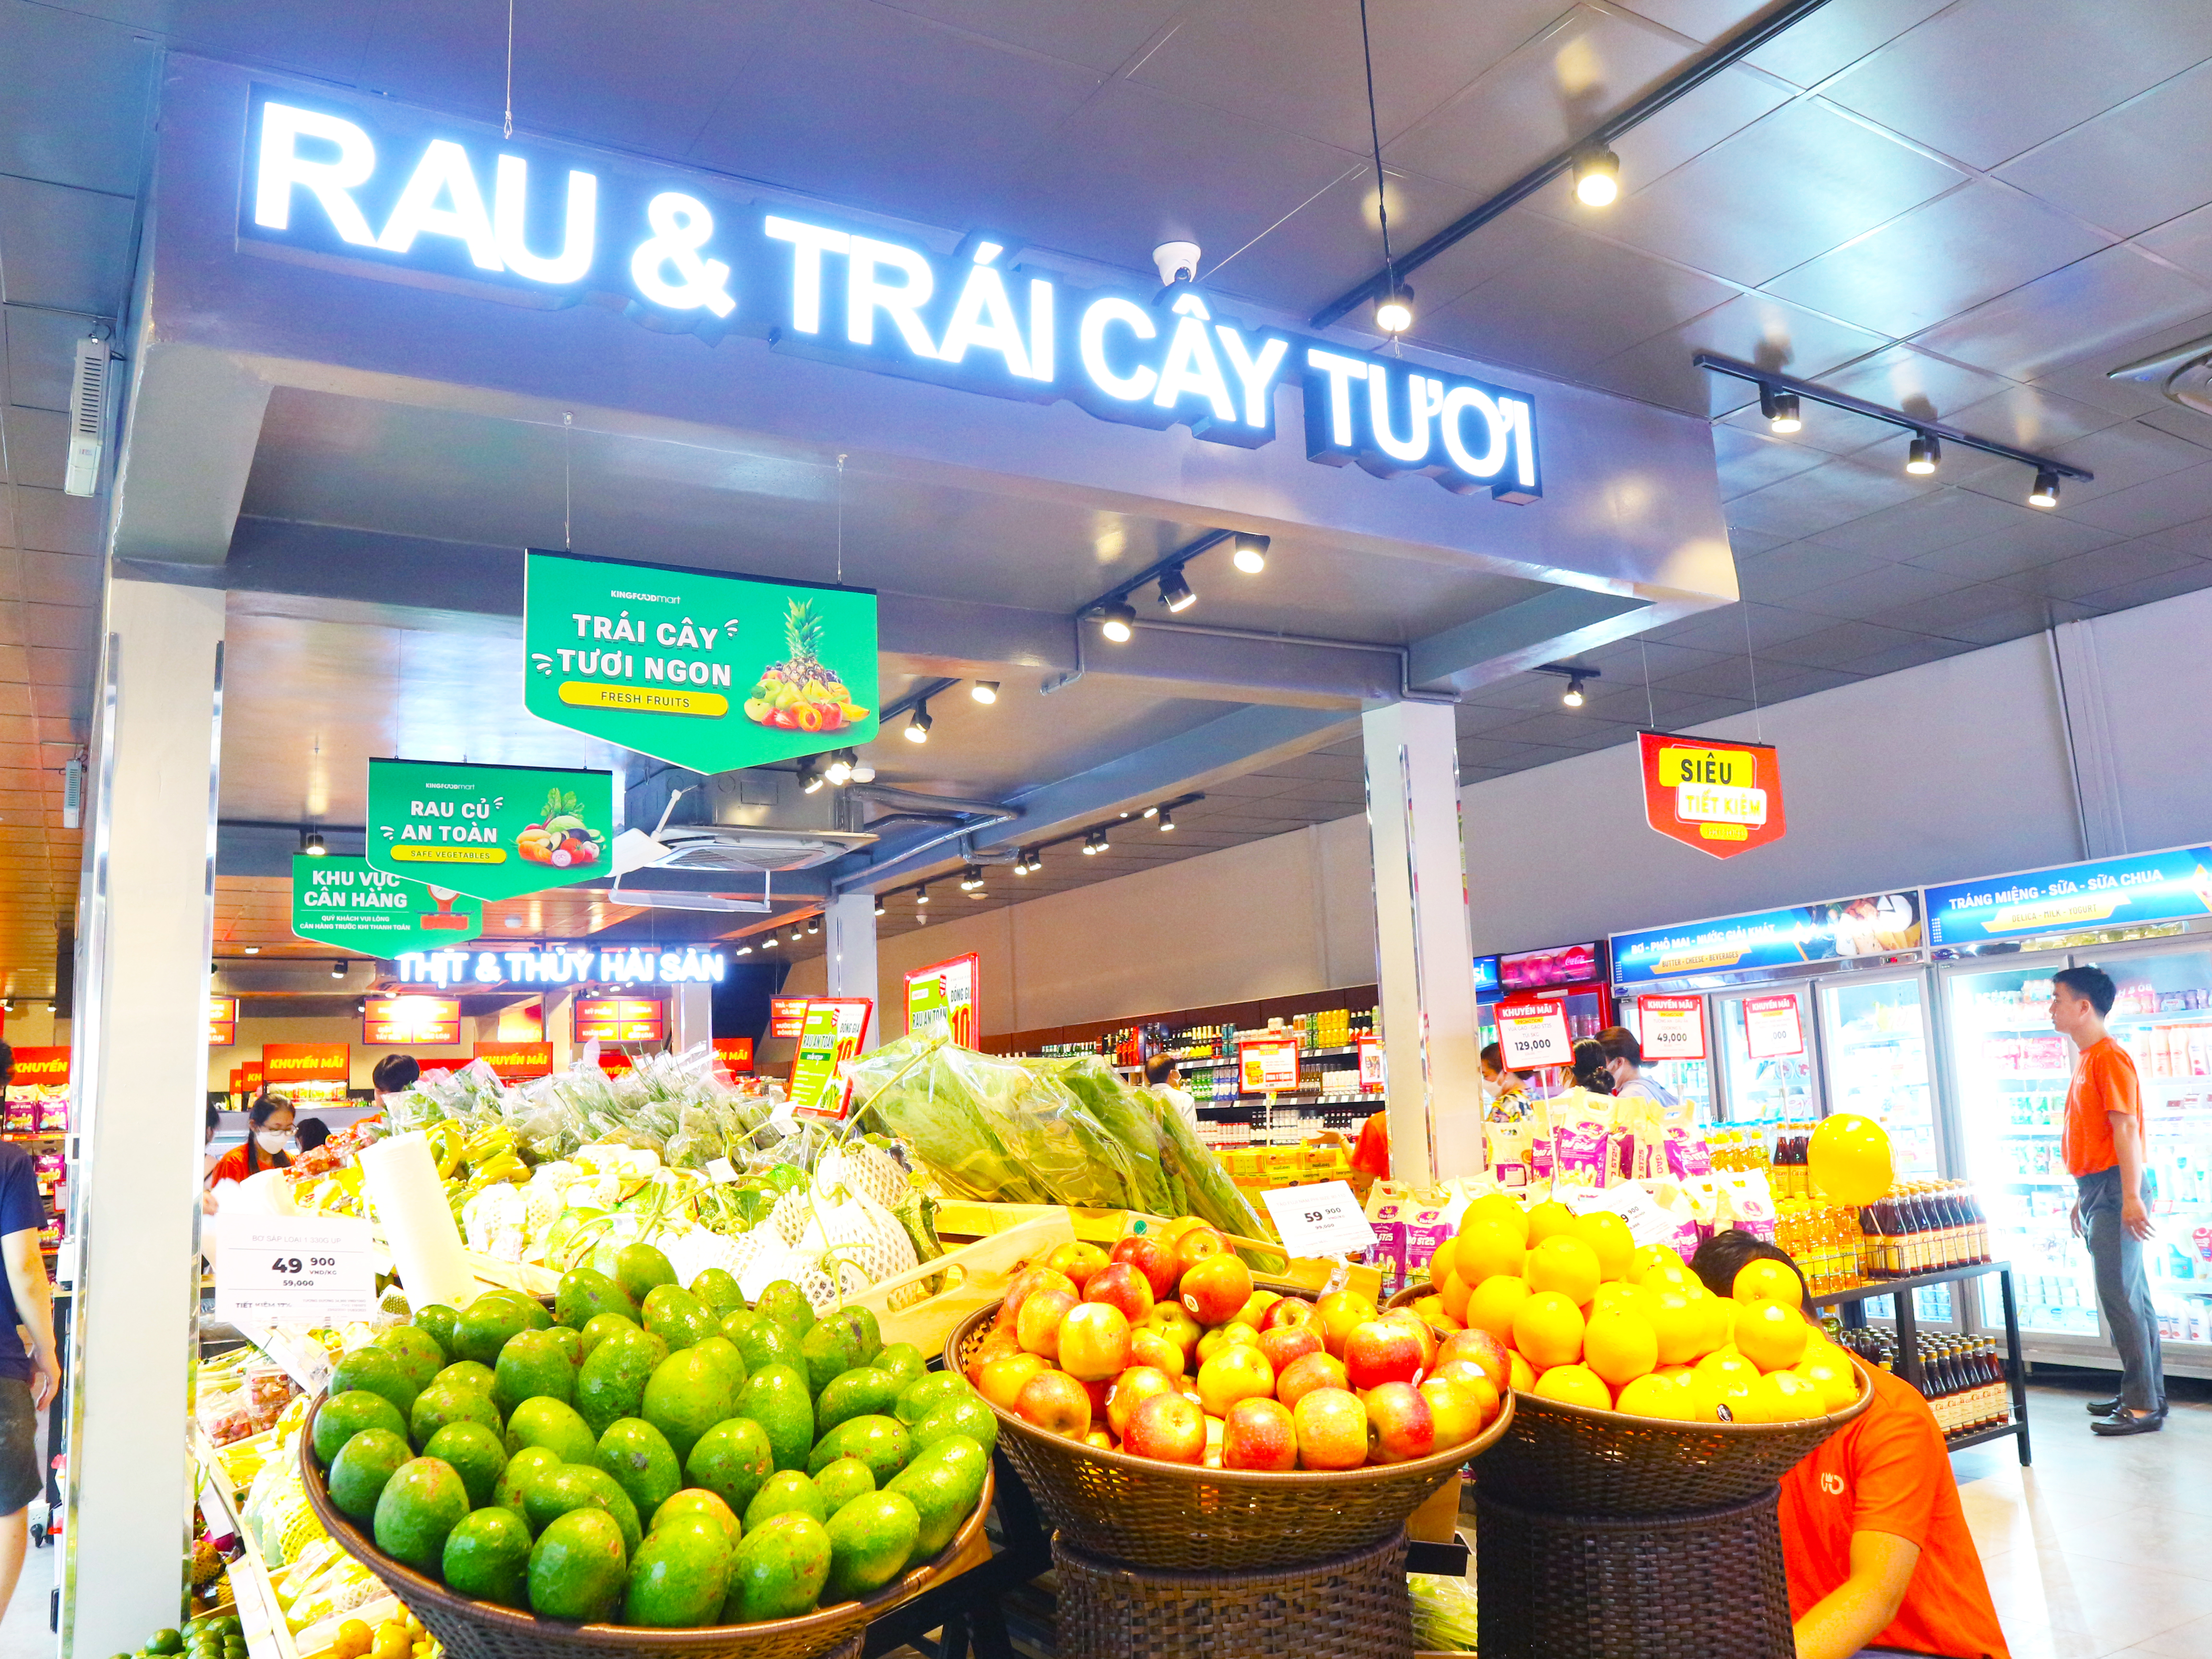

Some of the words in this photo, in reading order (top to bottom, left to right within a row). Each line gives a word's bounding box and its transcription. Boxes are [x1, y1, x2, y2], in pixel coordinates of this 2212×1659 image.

[255, 101, 596, 283] RAU
[631, 192, 735, 318] &
[766, 215, 1053, 382] TRÁI
[1080, 293, 1288, 428] CÂY
[1308, 349, 1535, 486] TƯƠI
[572, 610, 645, 644] TRÁI
[656, 617, 718, 649] CÂY
[557, 648, 633, 678] TƯƠI
[644, 657, 731, 687] NGON
[601, 691, 642, 704] FRESH
[647, 695, 690, 708] FRUITS
[1681, 752, 1731, 784] SIÊU
[410, 801, 454, 817] RAU
[461, 798, 490, 819] CỦ
[1686, 788, 1719, 813] TIẾT
[1724, 793, 1761, 820] KIỆM
[401, 825, 432, 841] AN
[439, 822, 497, 843] TOÀN
[313, 870, 354, 886] KHU
[304, 887, 346, 906] CÂN
[352, 888, 407, 908] HÀNG
[1949, 892, 1993, 910] TRÁNG
[1996, 886, 2038, 904] MIỆNG
[2048, 879, 2077, 896] SỮA
[2088, 875, 2118, 891] SỮA
[2120, 869, 2163, 886] CHUA
[2012, 914, 2037, 922] DELICA
[2044, 909, 2060, 918] MILK
[2068, 904, 2097, 915] YOGURT
[1631, 943, 1645, 954] BƠ
[1651, 938, 1671, 951] PHÔ
[1672, 938, 1690, 949] MAI
[1697, 930, 1724, 945] NƯỚC
[1686, 956, 1704, 964] CHEESE
[1709, 951, 1738, 961] BEVERAGES
[395, 952, 469, 988] THỊT
[476, 953, 501, 982] &
[601, 947, 654, 982] HẢI
[660, 948, 724, 982] SẢN
[1503, 1005, 1536, 1017] KHUYẾN
[1537, 1004, 1552, 1014] MÃI
[1647, 999, 1678, 1009] KHUYẾN
[1678, 999, 1693, 1009] MÃI
[1752, 999, 1777, 1010] KHUYẾN
[1778, 998, 1790, 1008] MÃI
[913, 1011, 923, 1028] RAU
[924, 1009, 931, 1025] AN
[803, 1034, 812, 1047] RAU
[813, 1035, 820, 1048] AN
[1515, 1039, 1551, 1051] 129,000
[1658, 1033, 1687, 1043] 49,000
[270, 1055, 318, 1069] KHUYẾN
[321, 1056, 344, 1068] MÃI
[482, 1052, 525, 1065] KHUYẾN
[527, 1053, 548, 1065] MÃI
[729, 1049, 748, 1060] MÃI
[13, 1058, 68, 1073] KHUYẾN
[1305, 1212, 1322, 1222] 59
[1621, 1214, 1629, 1223] 9
[1628, 1206, 1639, 1214] 900
[1379, 1233, 1393, 1241] ST25
[1417, 1237, 1435, 1246] ST25
[272, 1258, 302, 1273] 49
[311, 1258, 335, 1266] 900
